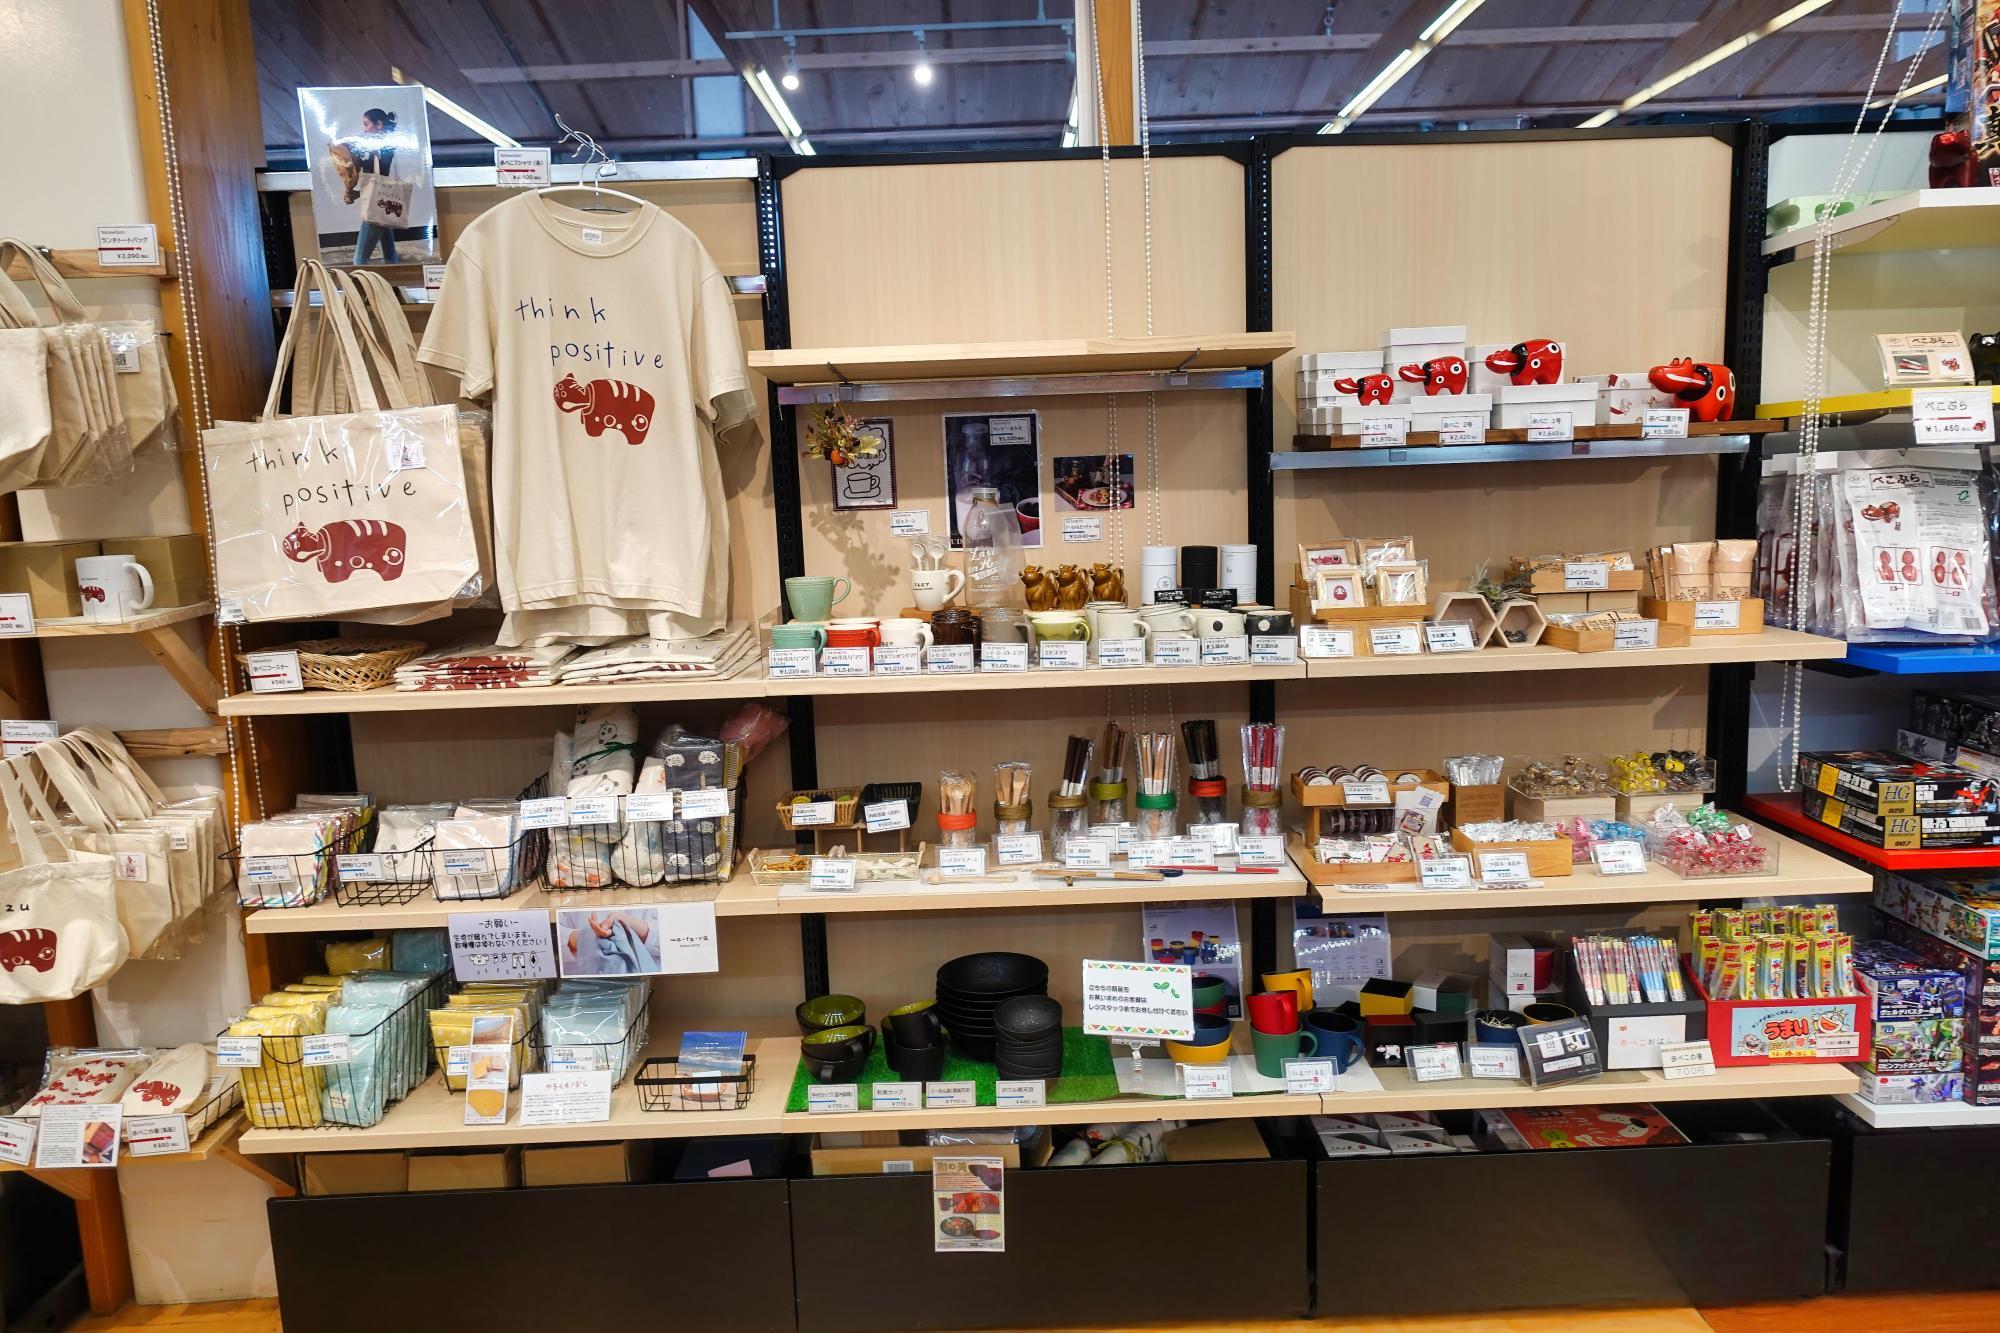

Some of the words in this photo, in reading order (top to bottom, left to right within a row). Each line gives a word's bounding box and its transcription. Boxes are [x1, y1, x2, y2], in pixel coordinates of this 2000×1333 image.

[515, 296, 606, 323] think
[551, 340, 664, 369] positive
[245, 438, 343, 473] think
[283, 478, 416, 515] positive
[1884, 784, 1909, 801] HG
[1889, 817, 1916, 834] HG
[1764, 1018, 1809, 1041] うまい
